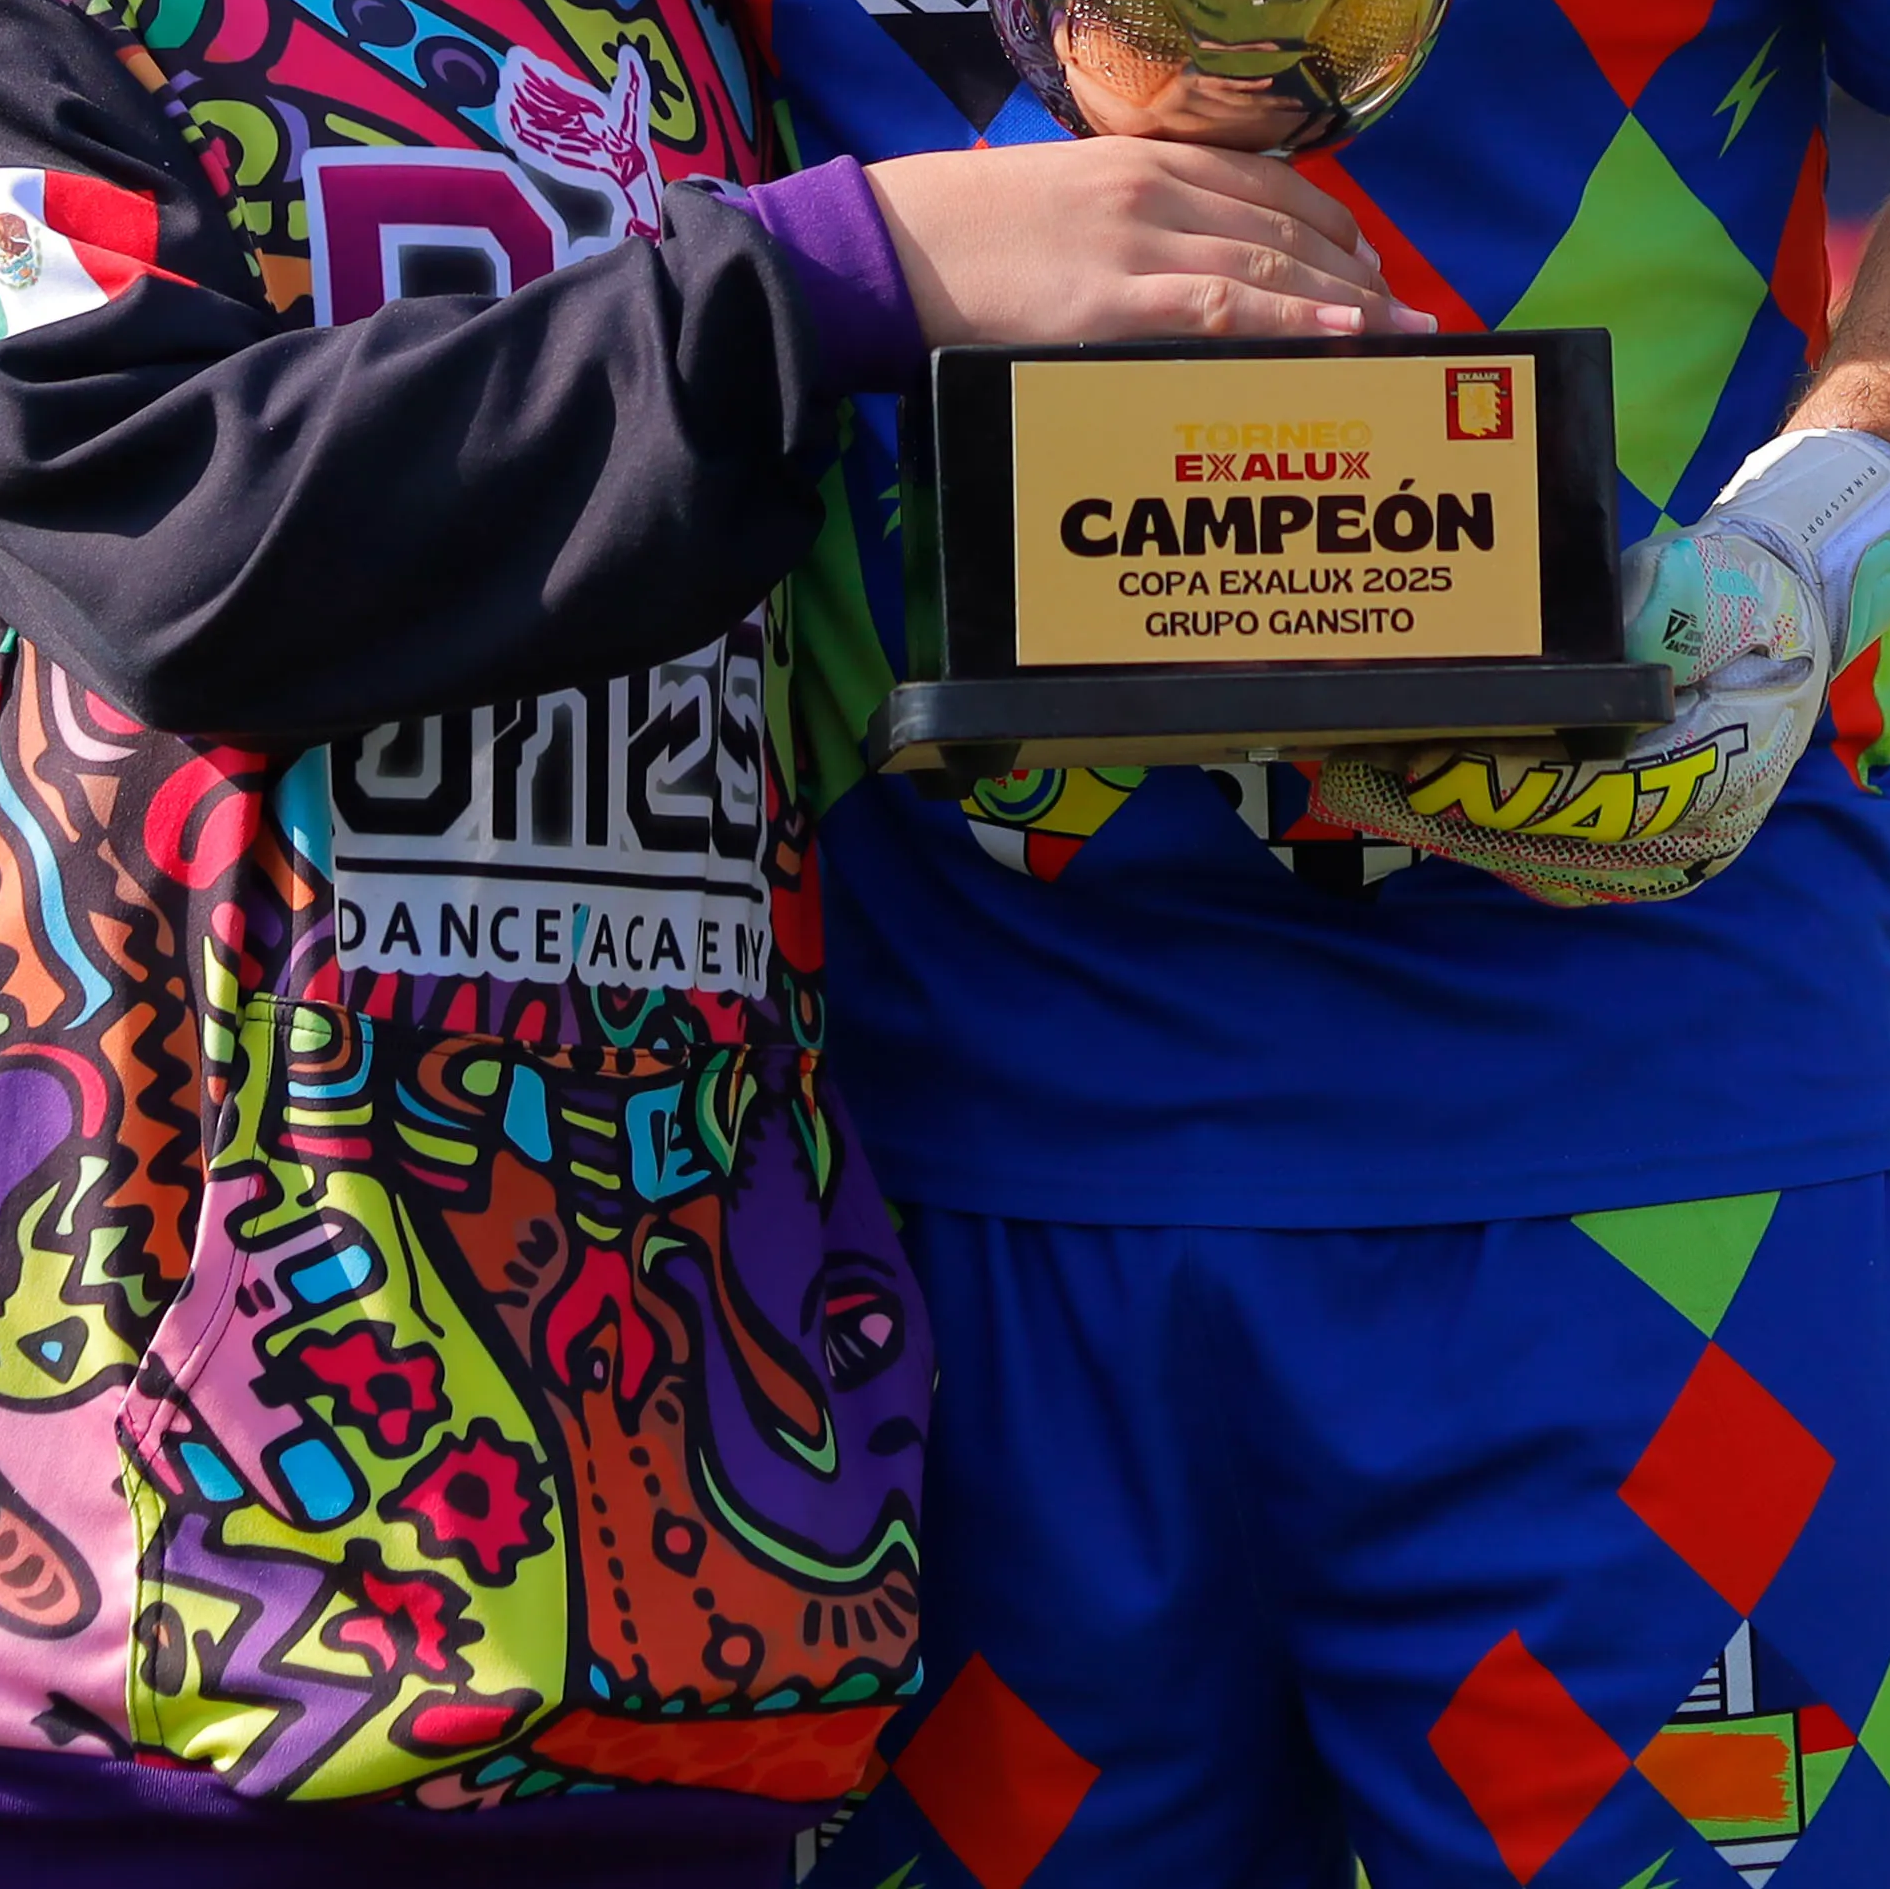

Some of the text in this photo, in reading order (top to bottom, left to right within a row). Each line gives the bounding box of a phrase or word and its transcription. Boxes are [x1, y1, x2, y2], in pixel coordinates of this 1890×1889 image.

[1175, 420, 1372, 450] TORNEO
[1175, 452, 1371, 482] EXALUX
[1060, 479, 1494, 557] CAMPEÓN
[1119, 567, 1453, 597] COPA EXALUX 2025
[1146, 608, 1415, 637] GRUPO GANSITO
[338, 899, 561, 963] DANCE
